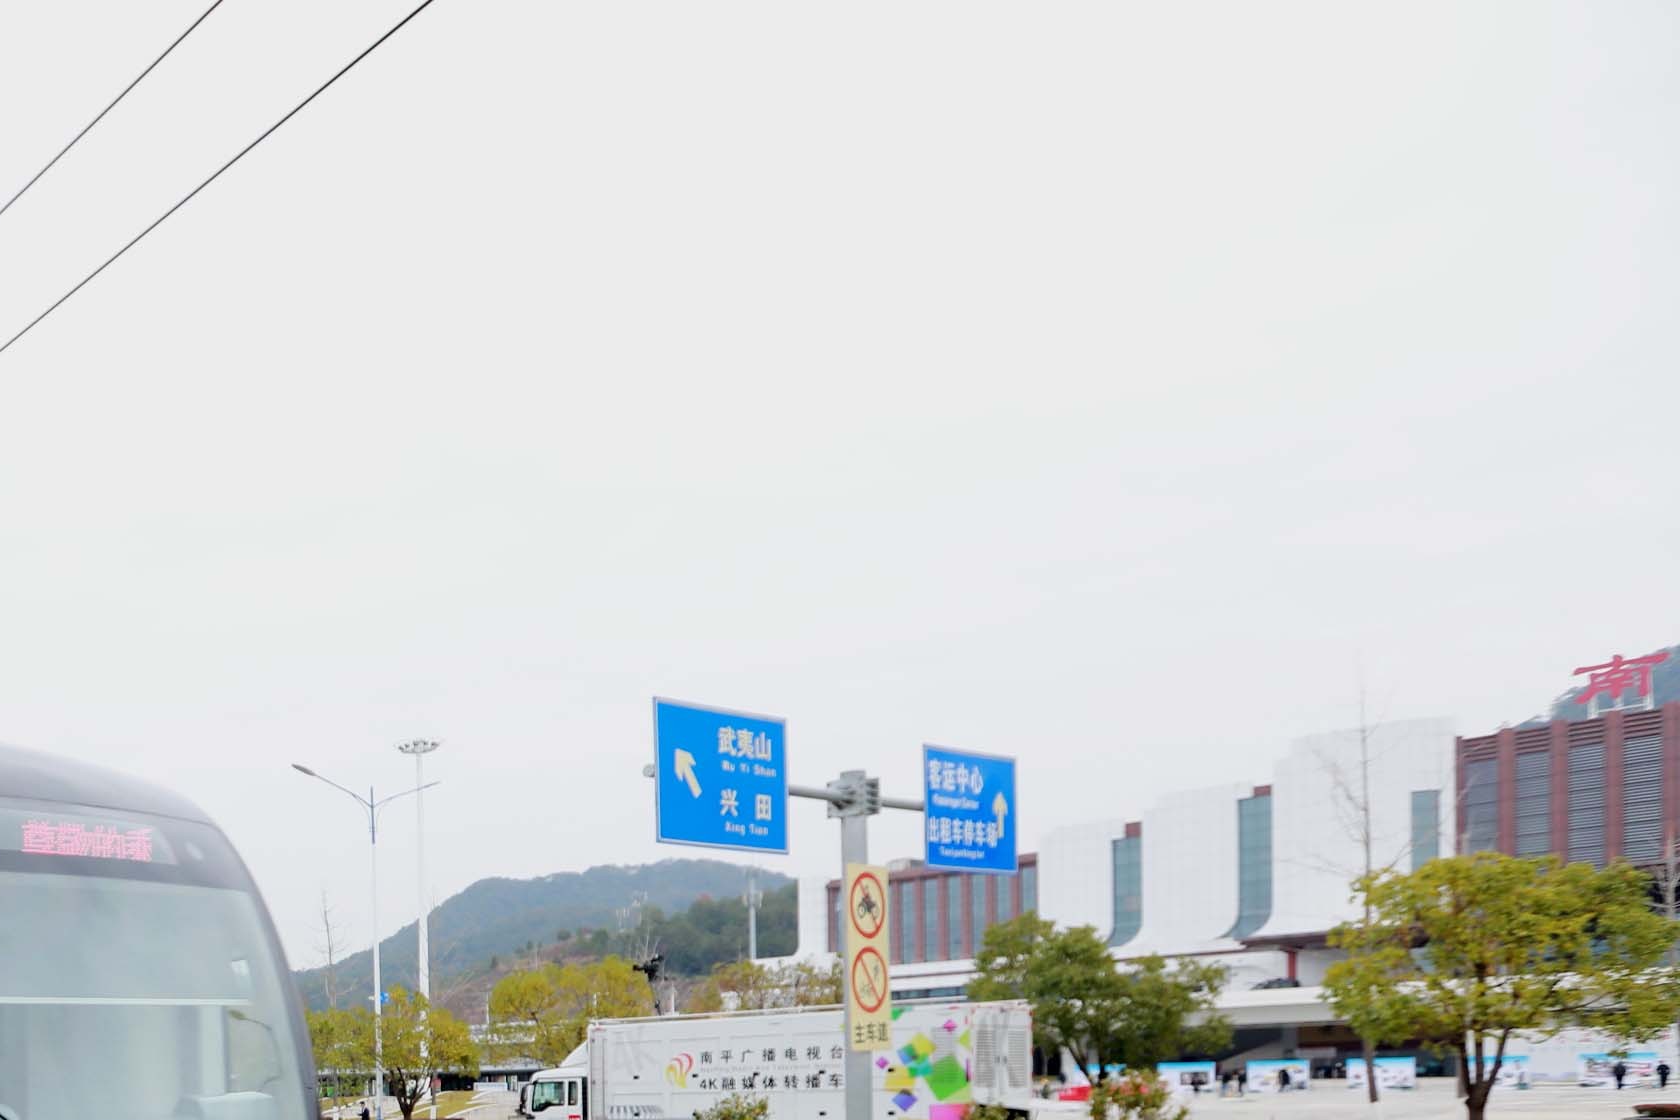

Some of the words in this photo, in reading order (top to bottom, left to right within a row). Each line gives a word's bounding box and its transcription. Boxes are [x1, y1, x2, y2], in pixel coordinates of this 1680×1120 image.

[1572, 651, 1671, 705] 南
[717, 725, 772, 762] 武夷山
[700, 1044, 844, 1064] 南平广播电视台
